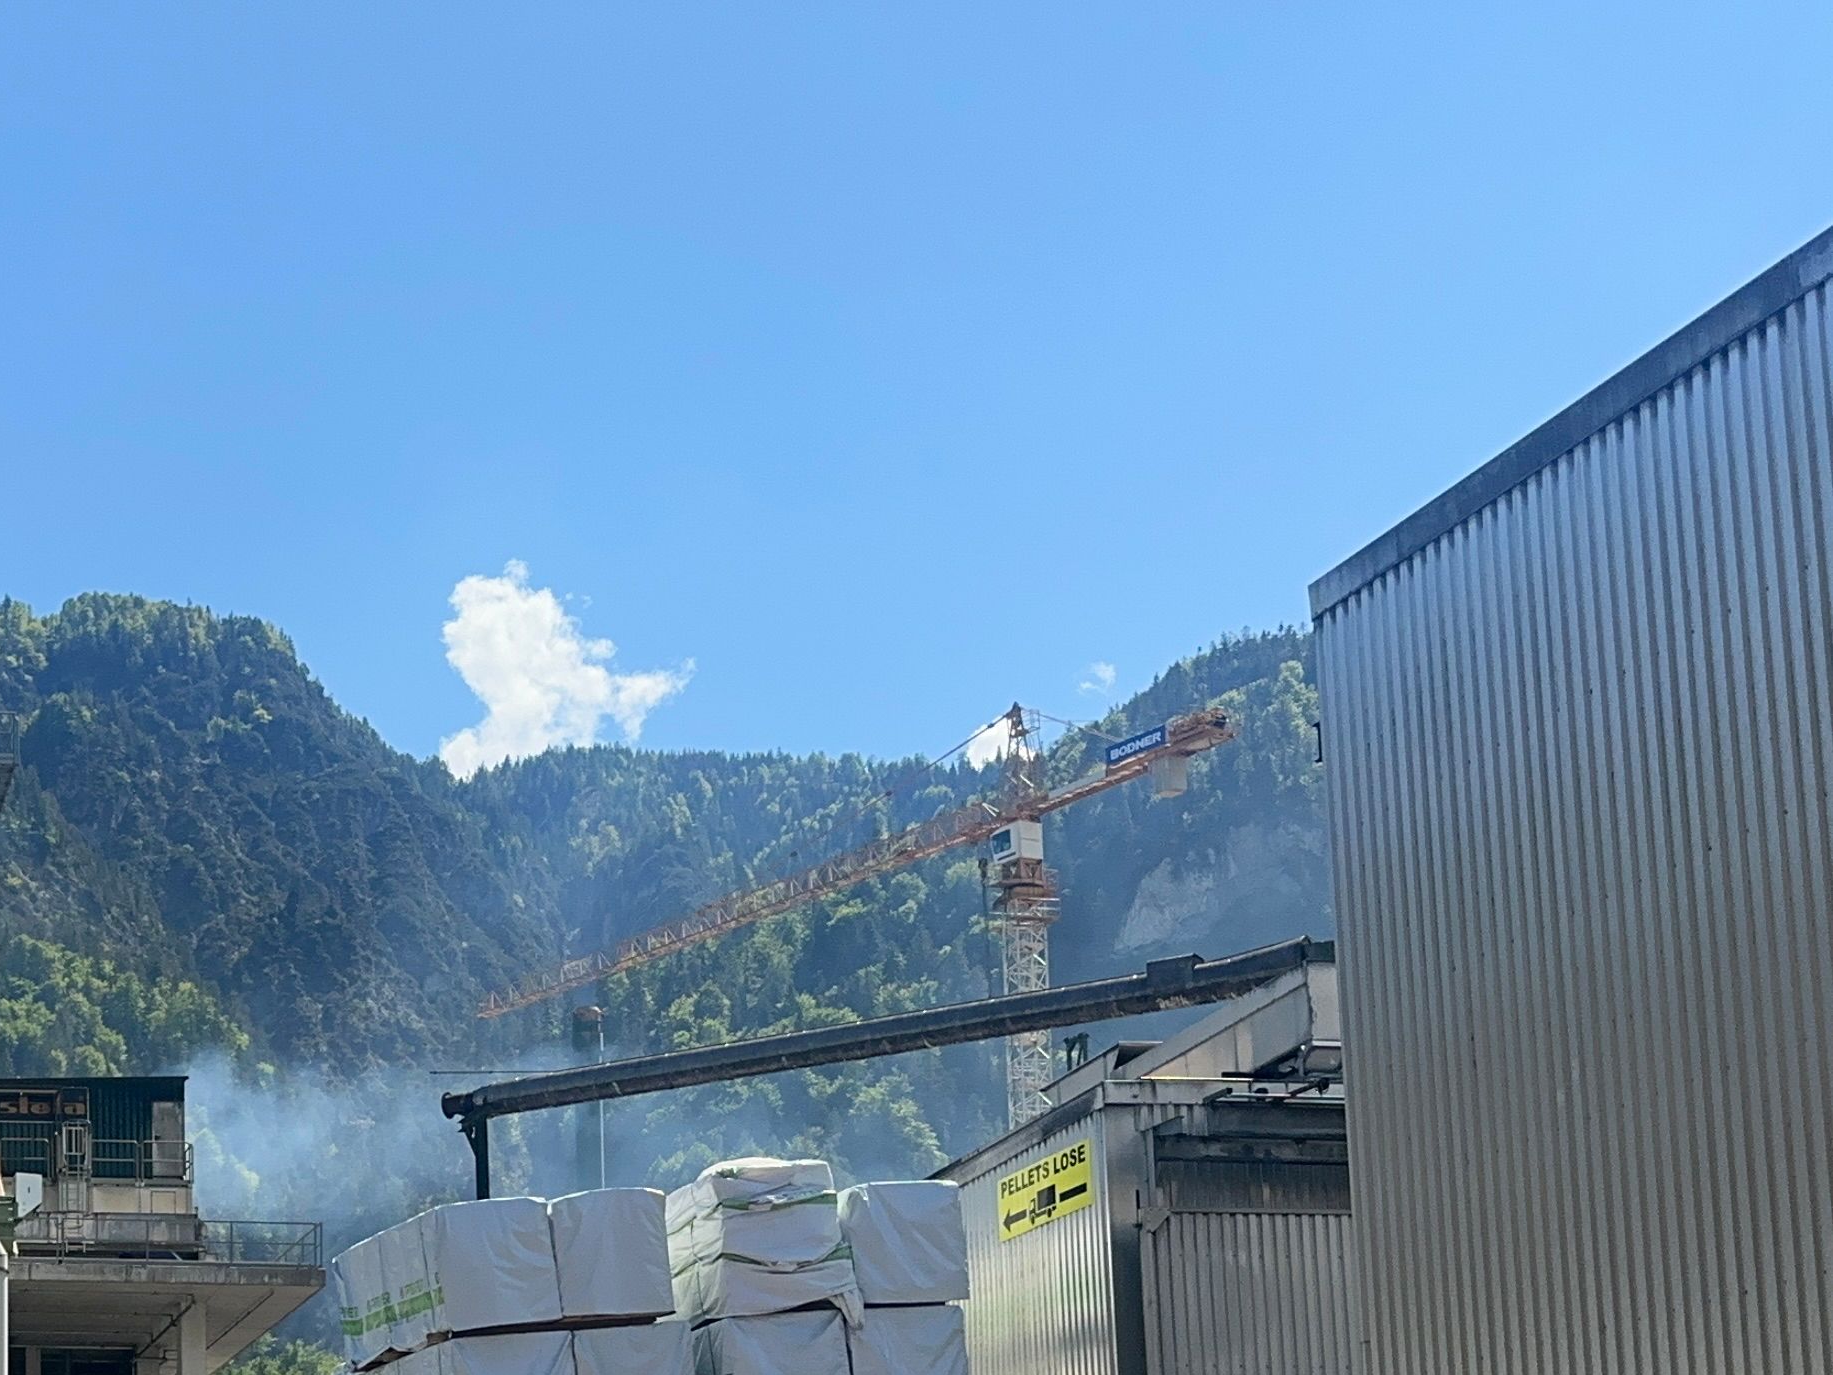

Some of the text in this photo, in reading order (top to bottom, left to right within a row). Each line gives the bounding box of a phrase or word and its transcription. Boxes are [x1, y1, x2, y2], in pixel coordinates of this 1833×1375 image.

[1110, 731, 1162, 760] BODNER
[0, 1096, 86, 1116] stea
[1000, 1144, 1086, 1199] PELLETS LOSE
